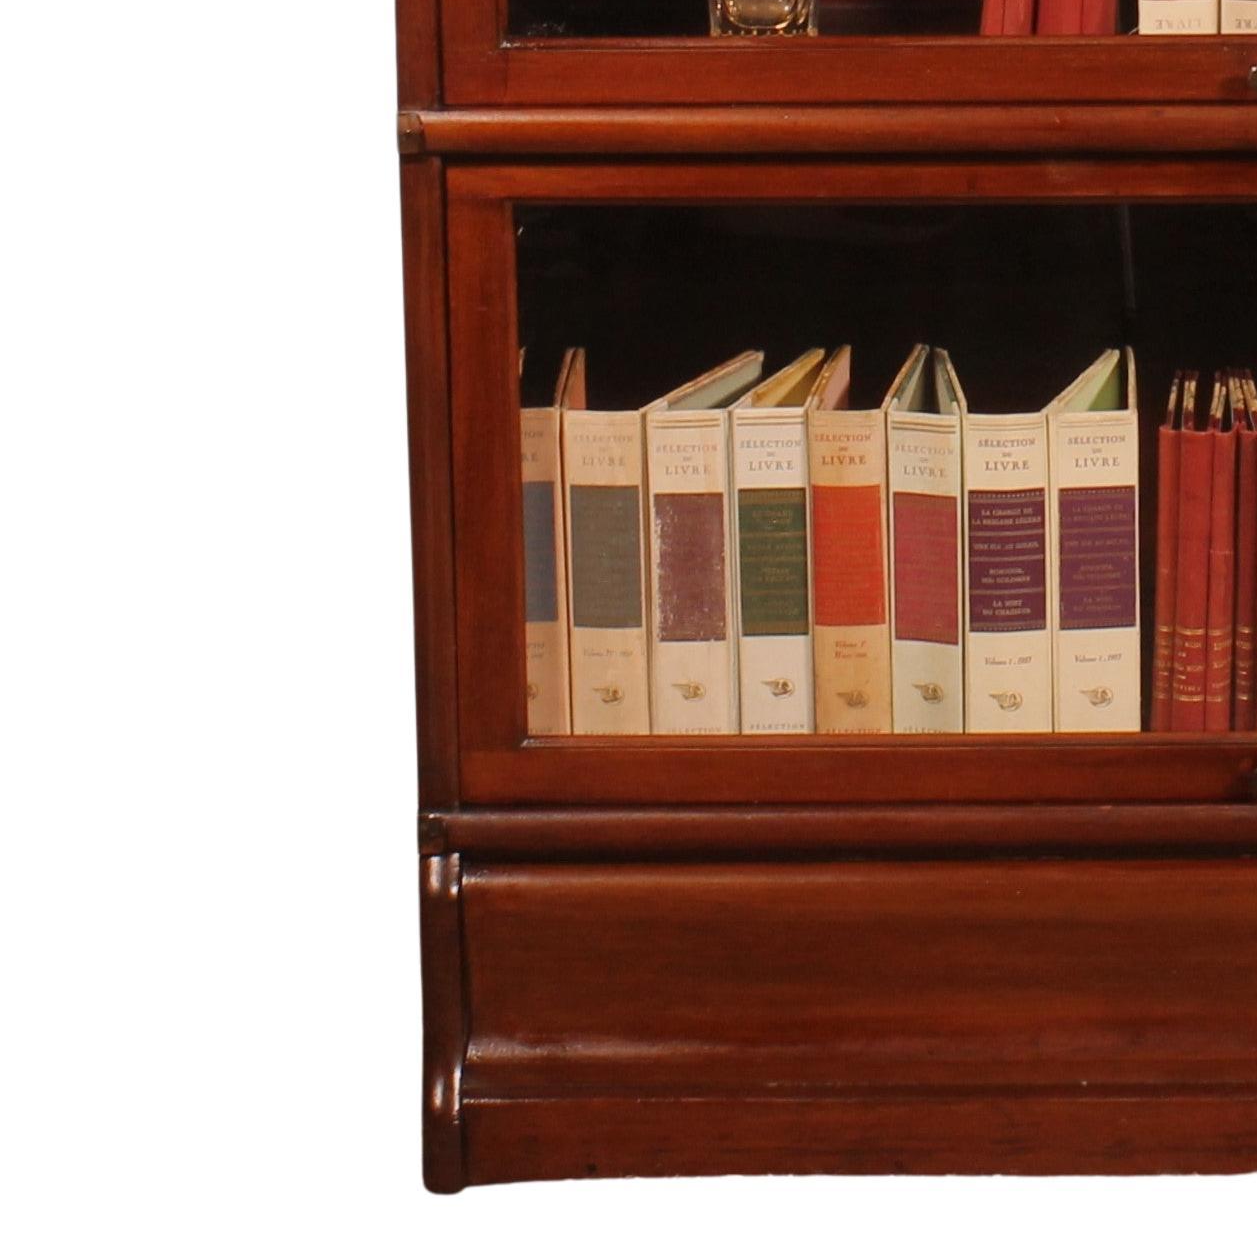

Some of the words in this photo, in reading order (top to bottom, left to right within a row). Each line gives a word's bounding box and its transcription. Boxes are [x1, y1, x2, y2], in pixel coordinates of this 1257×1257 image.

[1155, 18, 1200, 30] LIVRE
[977, 438, 1036, 448] SÉLECTION
[1067, 434, 1126, 445] SÉLECTION
[581, 455, 626, 467] LIVRE
[748, 459, 794, 471] LIVRE
[821, 454, 867, 466] LIVRE
[984, 460, 1030, 472] LIVRE
[1074, 456, 1121, 469] LIVRE
[665, 465, 712, 476] LIVRE
[903, 465, 947, 479] LIVRE
